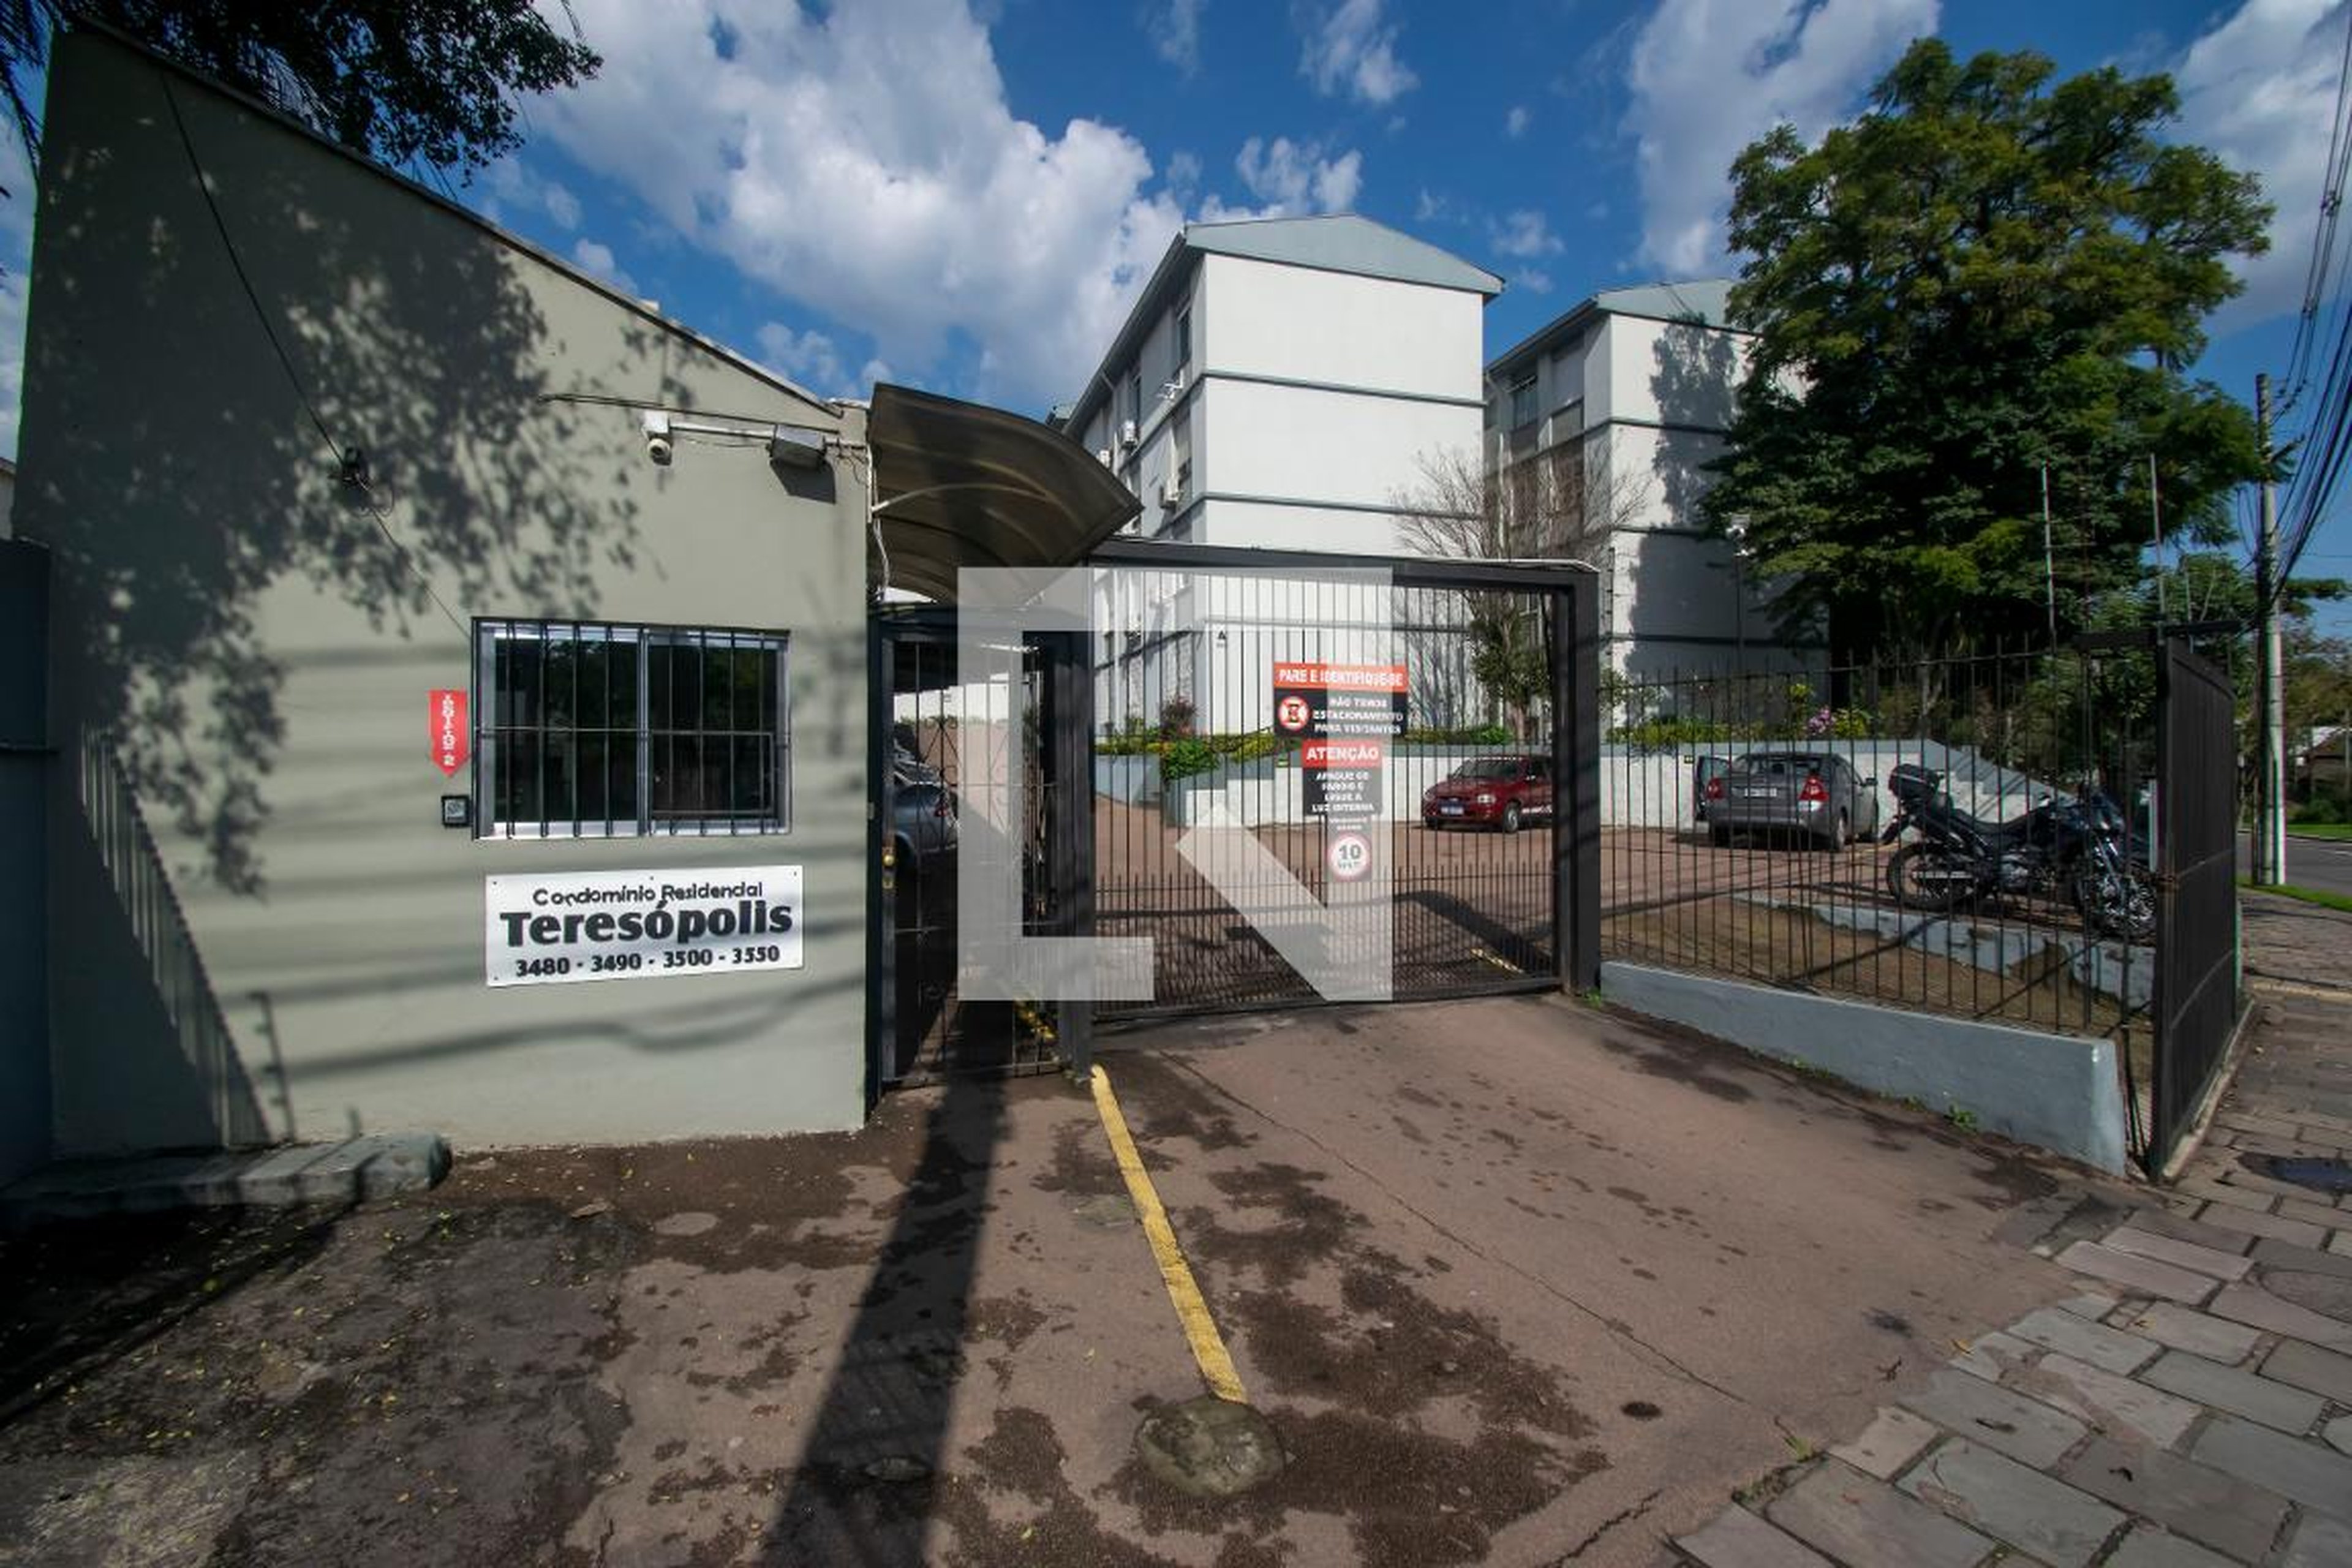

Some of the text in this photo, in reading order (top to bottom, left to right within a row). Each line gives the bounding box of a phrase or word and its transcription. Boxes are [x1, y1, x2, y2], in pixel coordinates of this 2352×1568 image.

[1279, 669, 1307, 683] PARE
[1310, 670, 1317, 683] E
[1306, 745, 1379, 763] ATENÇÃO
[1338, 845, 1362, 860] 10
[532, 884, 656, 907] Condomínio
[499, 899, 793, 948] Teresópolis
[515, 957, 570, 978] 3480
[590, 952, 642, 973] 3490
[663, 949, 713, 968] 3500
[732, 945, 780, 964] 3550
